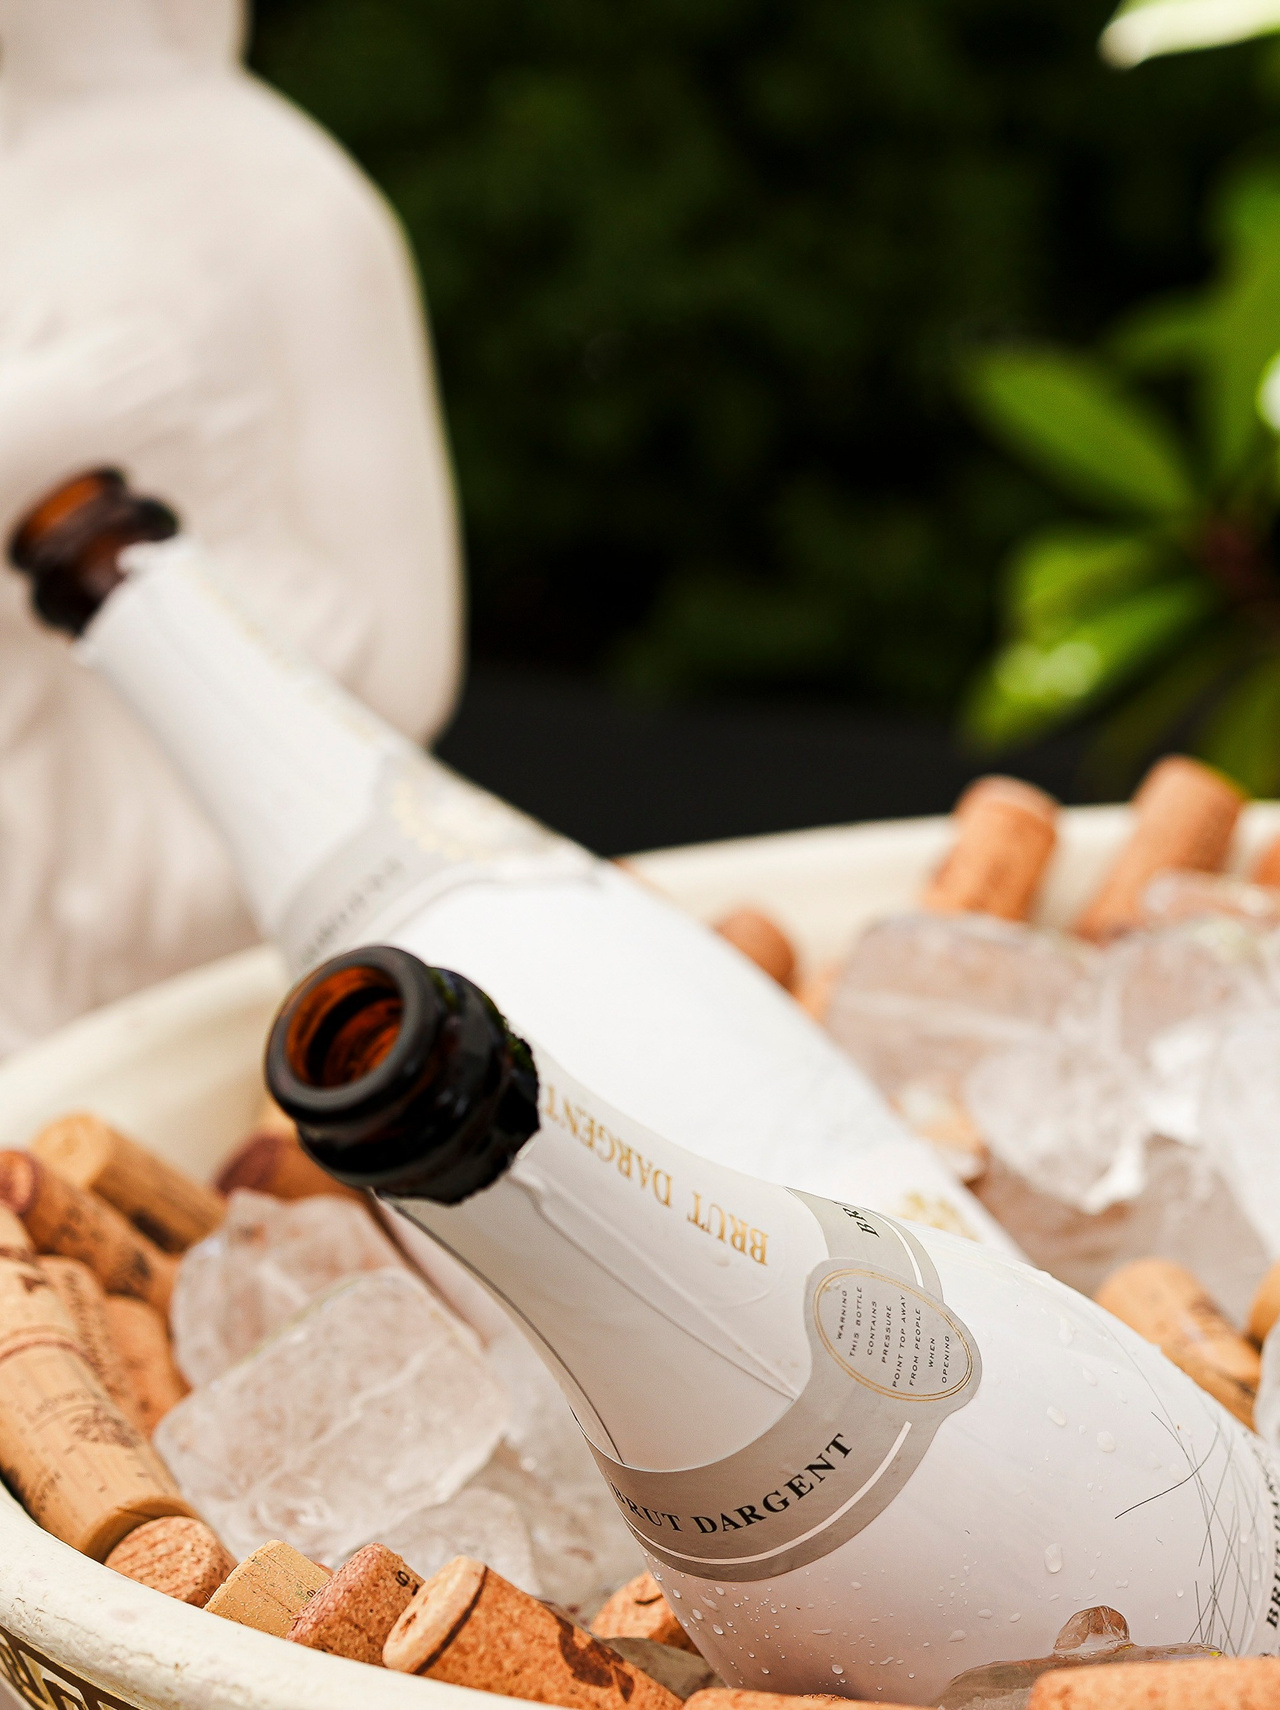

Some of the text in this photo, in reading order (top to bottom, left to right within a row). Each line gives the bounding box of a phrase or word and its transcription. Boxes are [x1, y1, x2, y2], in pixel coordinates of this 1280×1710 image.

[542, 1083, 770, 1267] BRUT DARGENT
[832, 1199, 880, 1239] BR
[836, 1290, 848, 1340] WARNING
[848, 1286, 863, 1357] THIS BOTTLE
[866, 1300, 878, 1356] CONTAINS
[881, 1305, 892, 1364] PRESSURE
[892, 1294, 909, 1388] POINT TOP AWAY
[909, 1355, 919, 1386] FROM
[928, 1337, 936, 1369] WHEN
[941, 1335, 950, 1384] OPENING
[610, 1432, 853, 1535] BRUT DARGENT
